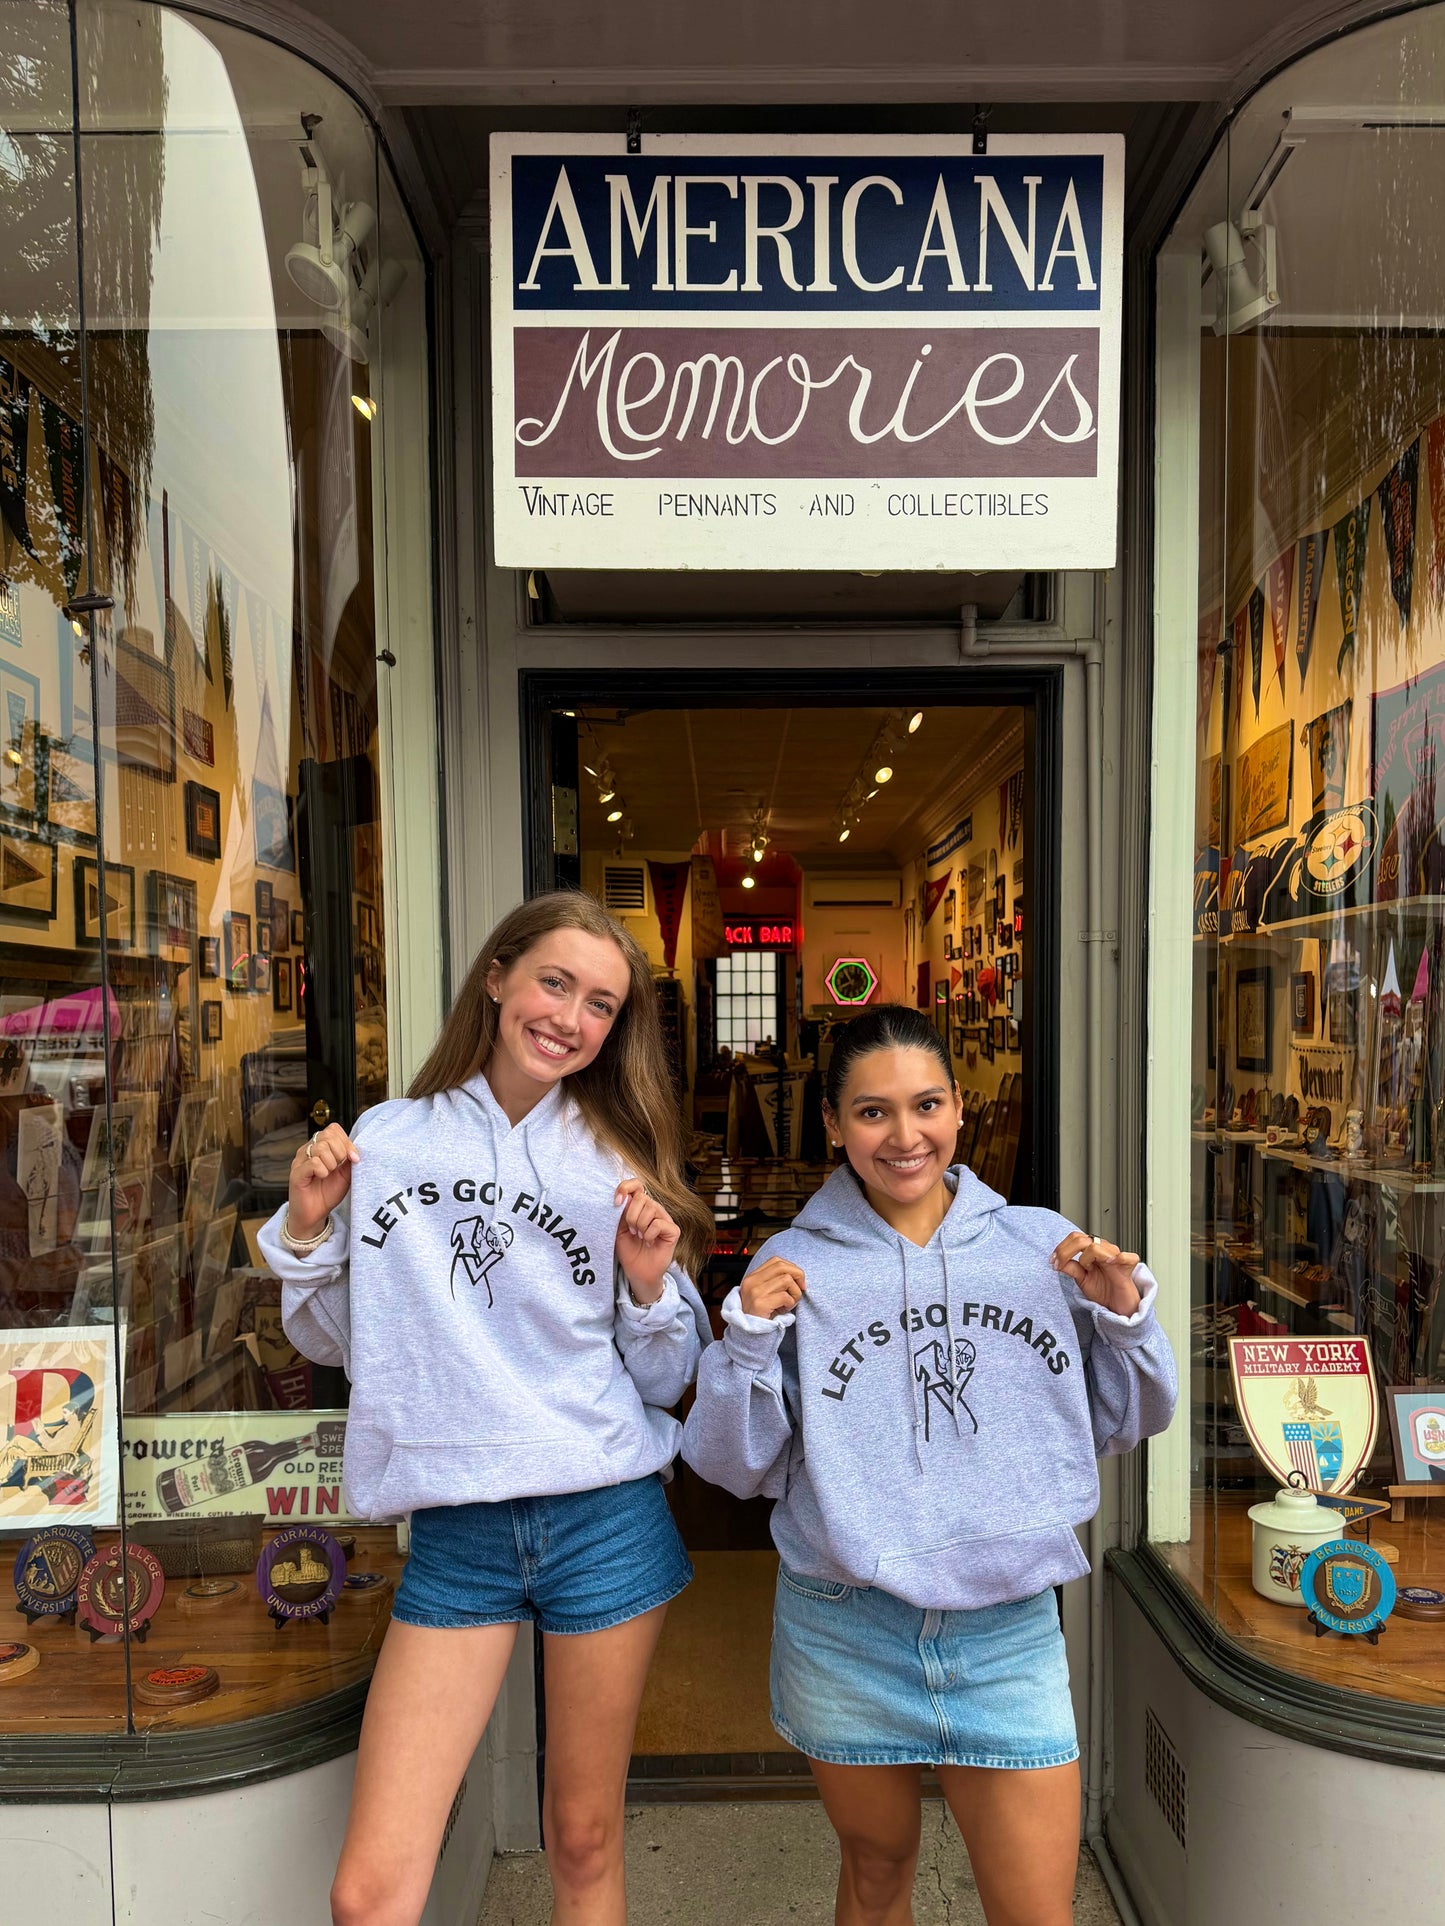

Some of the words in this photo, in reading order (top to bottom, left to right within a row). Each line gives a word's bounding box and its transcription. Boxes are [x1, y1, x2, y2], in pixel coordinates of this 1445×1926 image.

[518, 163, 1098, 293] AMERICANA
[515, 328, 1098, 462] Memories
[518, 486, 615, 517] VINTAGE
[657, 492, 778, 517] PENNANTS
[808, 493, 855, 517] AND
[887, 492, 1050, 517] COLLECTIBLES
[1344, 516, 1357, 635] OREGON
[1275, 571, 1285, 646] UTAH
[1296, 542, 1316, 654] MARQUETTE
[1312, 876, 1345, 893] STEELERS
[759, 926, 792, 943] BAR
[1298, 1054, 1344, 1104] Vermont
[360, 1182, 440, 1249] LET'S
[453, 1179, 503, 1205] GO
[511, 1192, 596, 1287] FRIARS
[821, 1321, 891, 1401] LET'S
[899, 1303, 948, 1332] GO
[962, 1302, 1070, 1375] FRIARS
[1243, 1345, 1289, 1362] NEW
[1298, 1343, 1360, 1362] YORK
[1243, 1363, 1300, 1374] MILITARY
[1304, 1362, 1362, 1373] ACADEMY
[122, 1436, 225, 1461] rowers
[1423, 1429, 1445, 1441] USN
[284, 1462, 315, 1474] OLD
[266, 1486, 341, 1516] WIN
[1344, 1506, 1365, 1518] DAME
[32, 1526, 94, 1558] MARQUETTE
[273, 1528, 329, 1549] FURMAN
[1315, 1542, 1383, 1568] BRANDEIS
[79, 1558, 100, 1603] BATES
[110, 1545, 161, 1580] COLLEGE
[16, 1580, 75, 1614] UNIVERSITY
[266, 1588, 336, 1617] UNIVERSITY
[1311, 1601, 1382, 1633] UNIVERSITY
